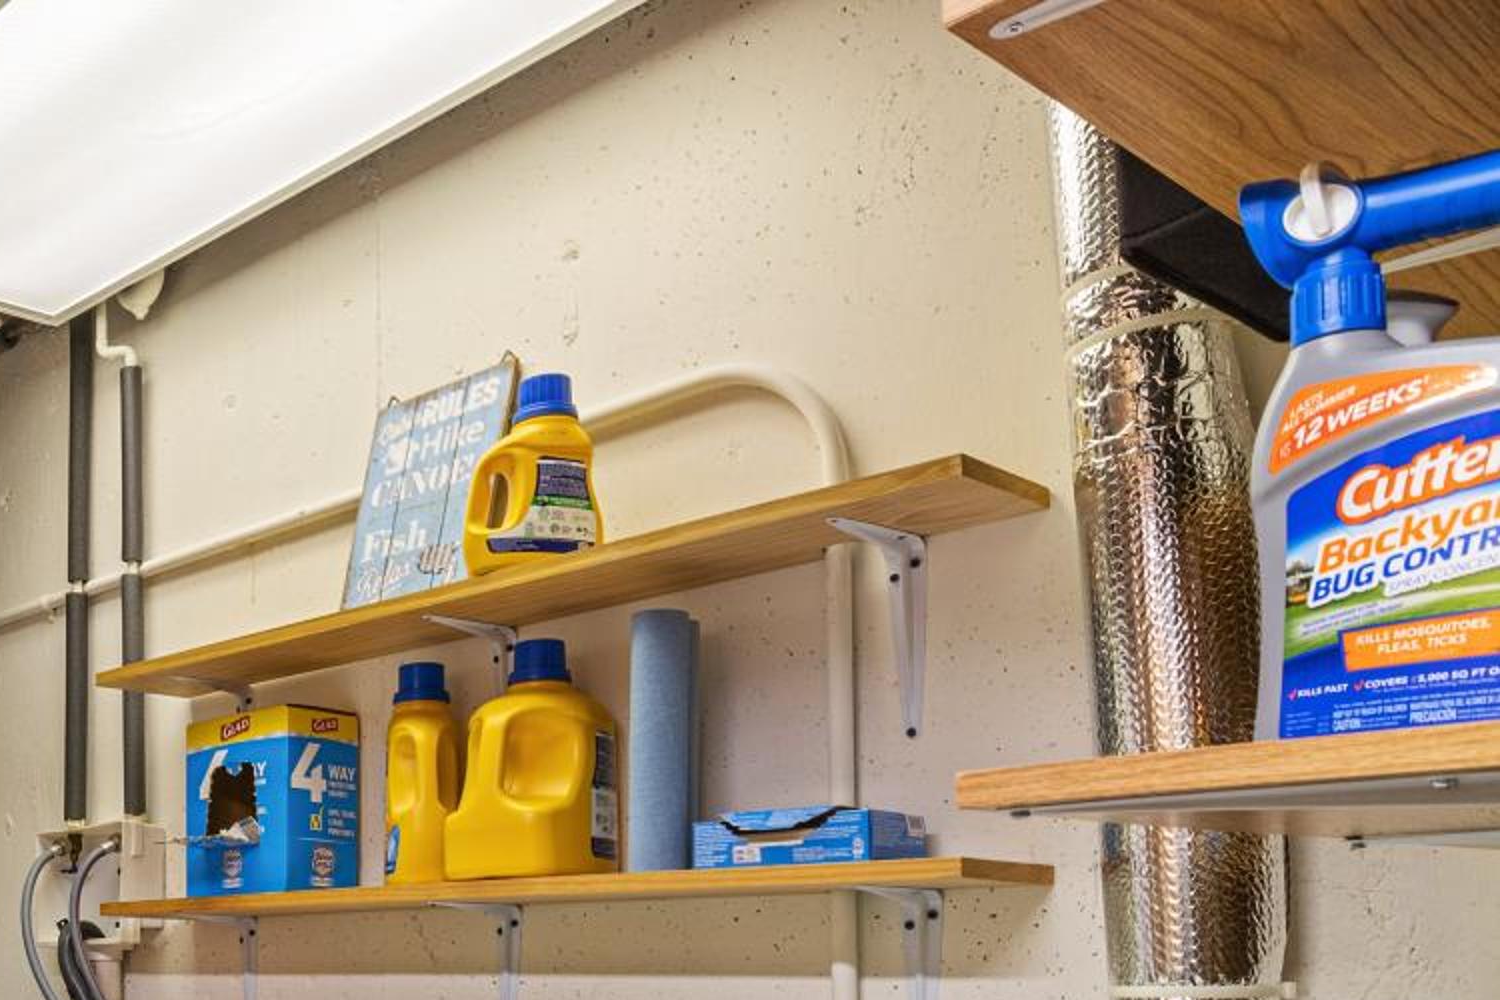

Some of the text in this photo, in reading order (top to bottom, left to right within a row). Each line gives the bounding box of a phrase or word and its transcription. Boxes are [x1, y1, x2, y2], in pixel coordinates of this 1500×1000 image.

[420, 421, 485, 459] Hike
[1294, 416, 1325, 450] 12
[364, 519, 428, 557] Fish
[1319, 496, 1500, 574] Backya
[1313, 562, 1376, 602] BUG
[1297, 683, 1349, 698] KILLS FAST
[1364, 675, 1409, 690] COVERS
[1471, 667, 1487, 678] FT
[290, 741, 327, 804] 4
[328, 764, 357, 782] WAY
